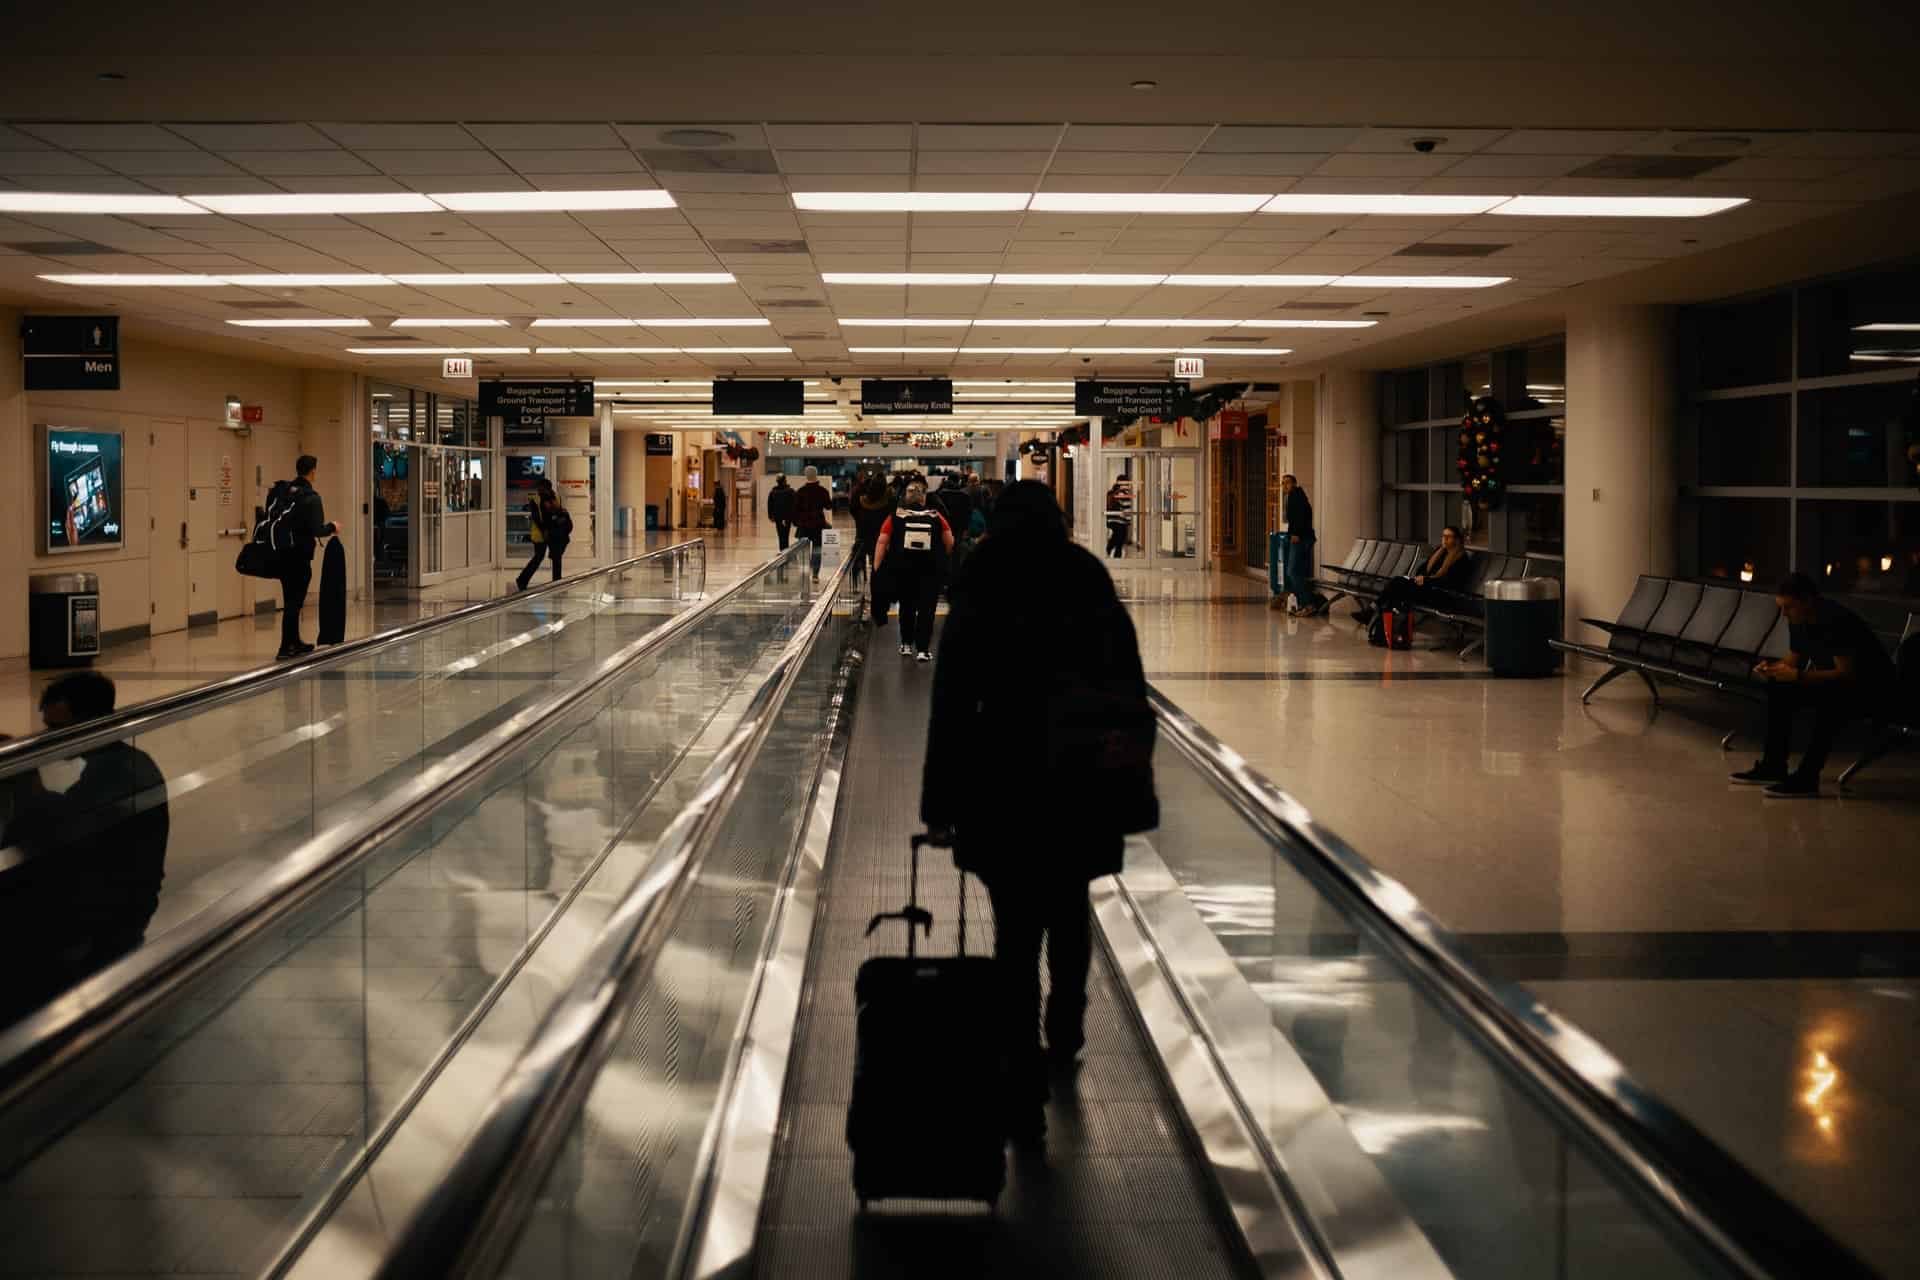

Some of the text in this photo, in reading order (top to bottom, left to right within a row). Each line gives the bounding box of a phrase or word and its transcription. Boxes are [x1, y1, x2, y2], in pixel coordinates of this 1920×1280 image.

[84, 360, 113, 374] Men
[447, 360, 467, 374] EXIT
[1178, 360, 1199, 373] EXIT
[496, 396, 566, 407] Ground Transport
[893, 400, 929, 411] Walkway
[930, 400, 951, 410] Ends
[1093, 396, 1162, 406] Ground Transport
[521, 406, 566, 414] Food Court
[1117, 406, 1162, 415] Food Court
